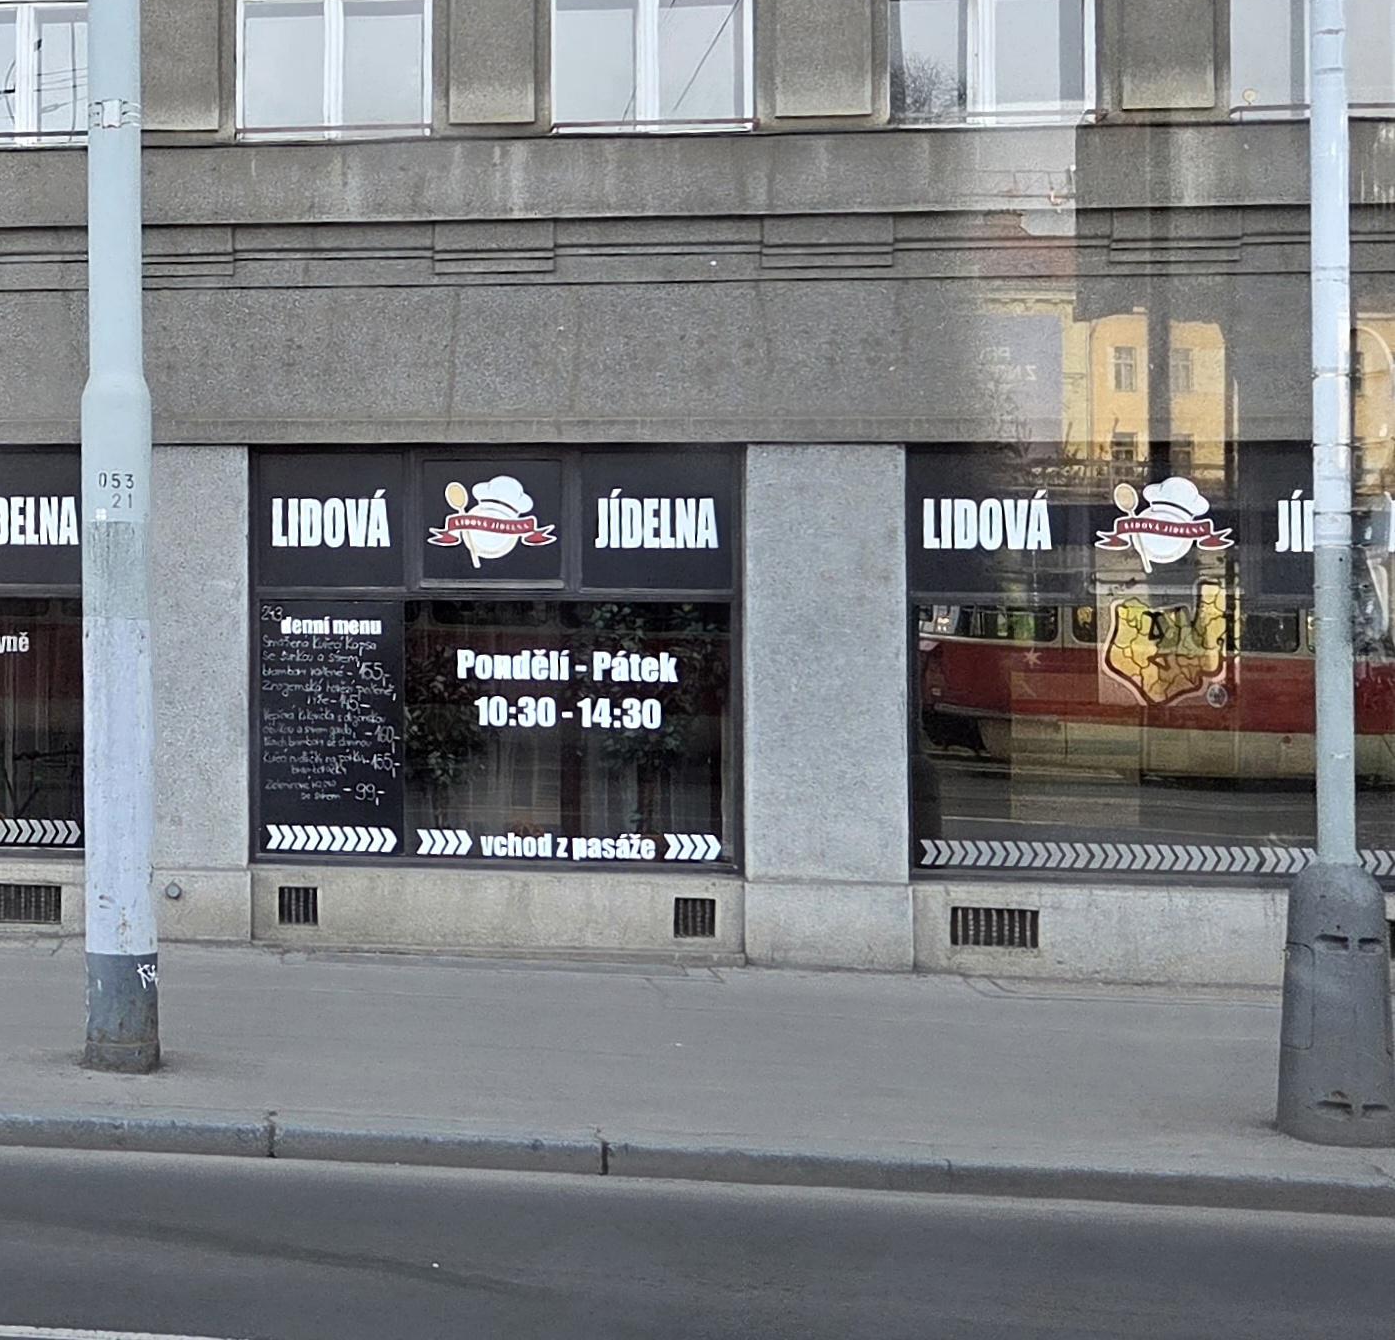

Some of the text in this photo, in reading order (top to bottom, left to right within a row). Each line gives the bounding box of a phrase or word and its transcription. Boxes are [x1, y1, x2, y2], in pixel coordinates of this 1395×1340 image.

[98, 472, 135, 489] 053
[111, 492, 133, 509] 21
[271, 488, 719, 549] LIDOVÁ JÍDELNA
[922, 489, 1053, 550] LIDOVÁ
[280, 616, 382, 635] denní menu
[456, 648, 570, 682] Pondělí
[592, 651, 679, 684] Pátek
[474, 696, 557, 729] 10:30
[577, 697, 662, 729] 14:30
[480, 833, 656, 861] vchod z pasáže
